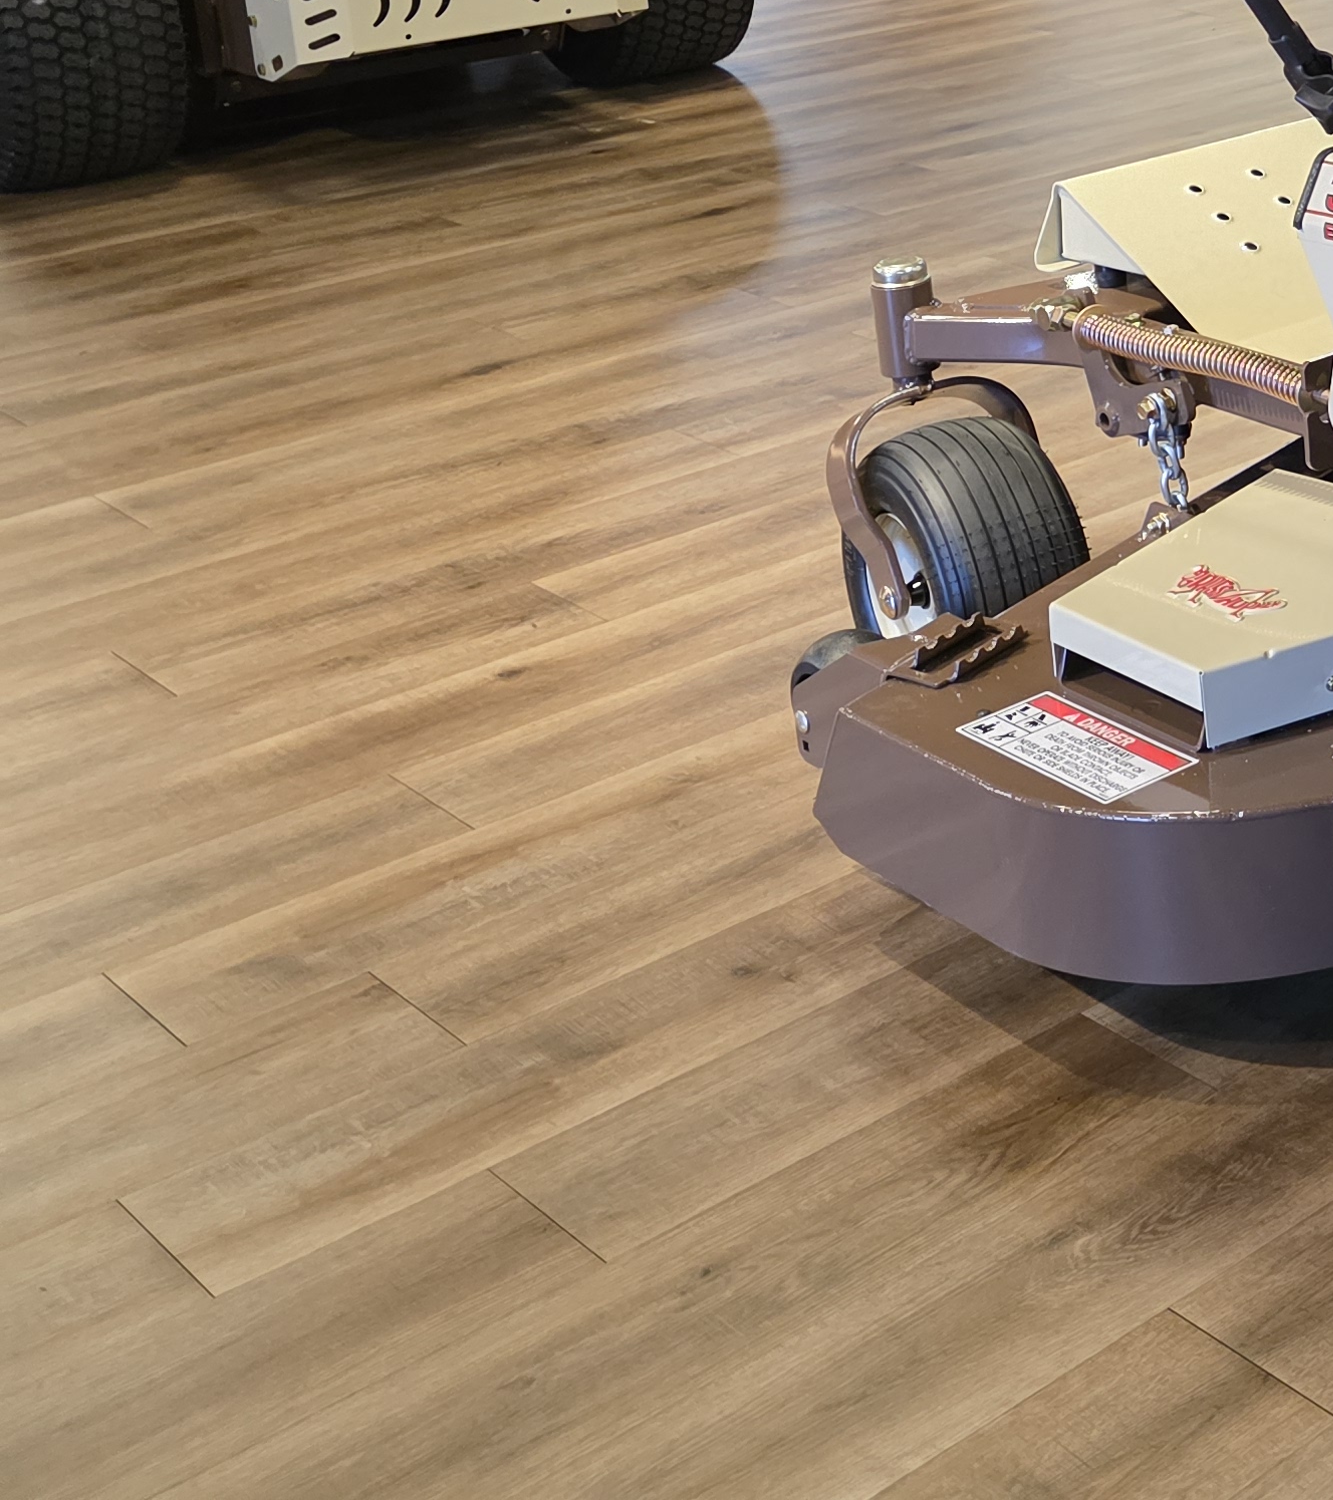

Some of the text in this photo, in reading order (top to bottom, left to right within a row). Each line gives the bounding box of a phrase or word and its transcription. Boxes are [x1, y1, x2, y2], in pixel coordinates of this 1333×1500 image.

[1074, 717, 1138, 747] DANGER
[1082, 735, 1109, 748] KEEP
[1016, 737, 1041, 750] NEVER
[1035, 746, 1067, 762] OPERATE
[1060, 759, 1093, 775] WITHOUT
[1041, 758, 1061, 768] SIDE
[1042, 733, 1068, 745] DEATH
[1061, 742, 1086, 754] FROM
[1106, 763, 1139, 780] OBJECTS
[1058, 749, 1083, 761] BLADE
[1064, 734, 1090, 747] AVOID
[1084, 744, 1115, 759] SERIOUS
[1109, 756, 1136, 769] INJURY
